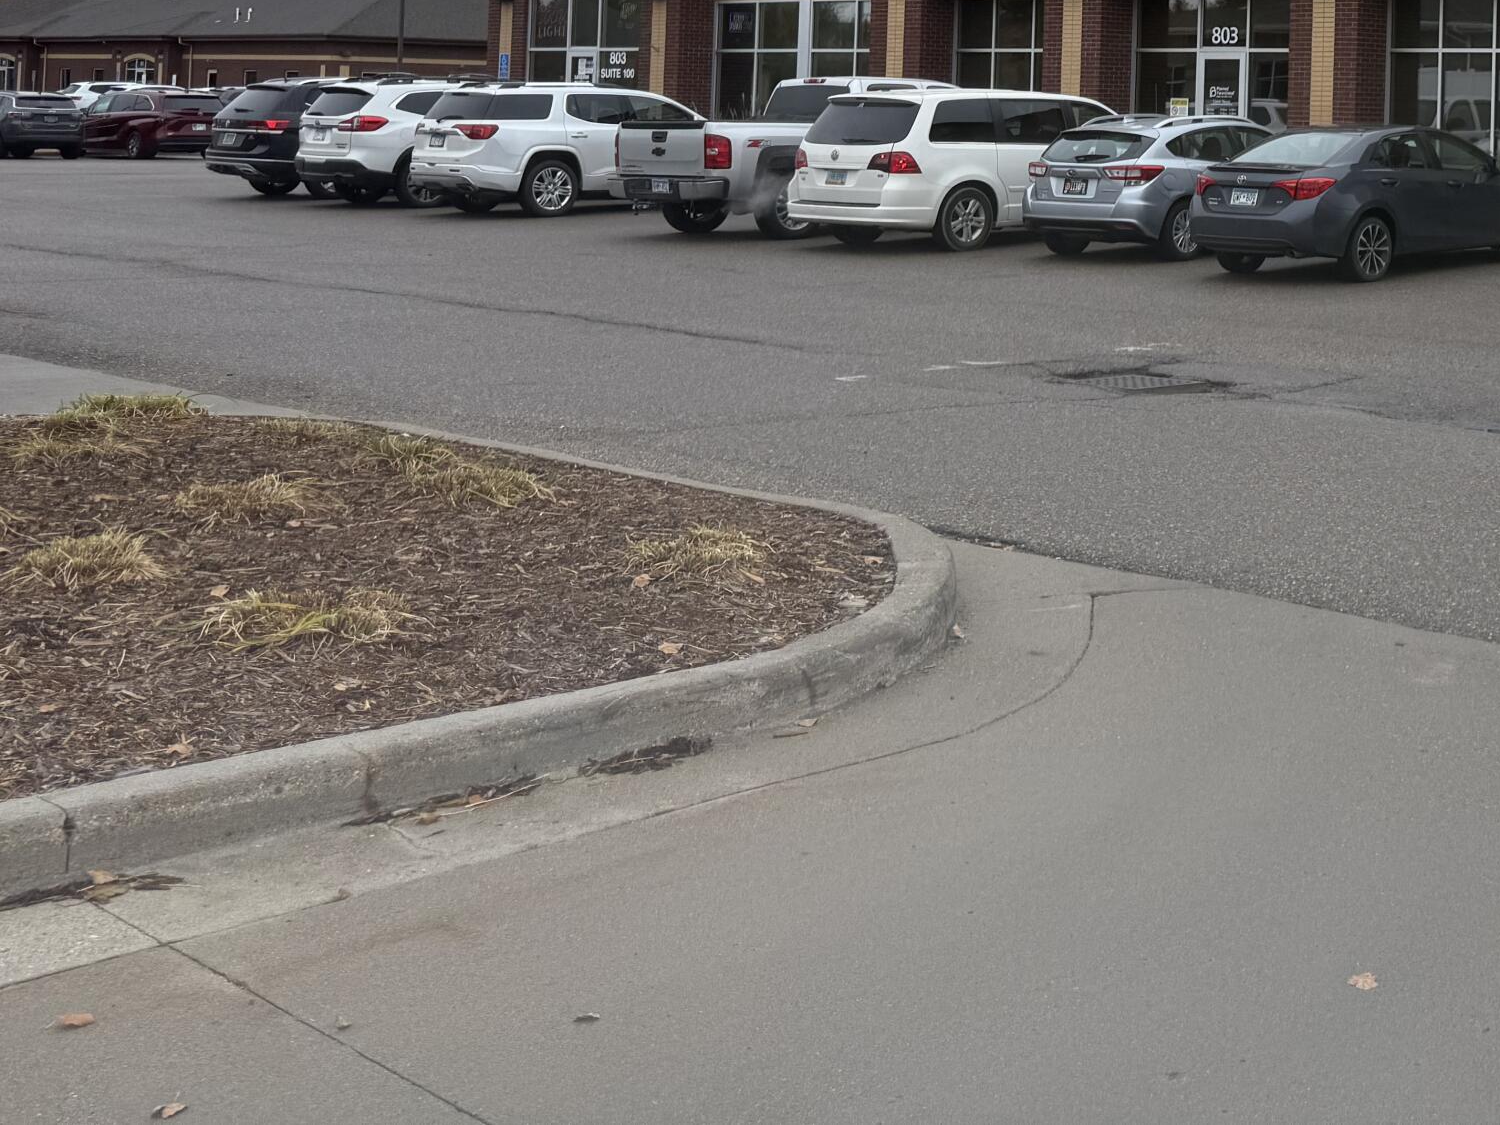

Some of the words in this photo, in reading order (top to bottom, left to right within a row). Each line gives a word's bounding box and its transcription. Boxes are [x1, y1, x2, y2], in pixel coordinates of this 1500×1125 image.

[1211, 26, 1239, 44] 803
[609, 52, 627, 65] 803
[600, 68, 622, 79] SUITE
[623, 68, 635, 79] 100
